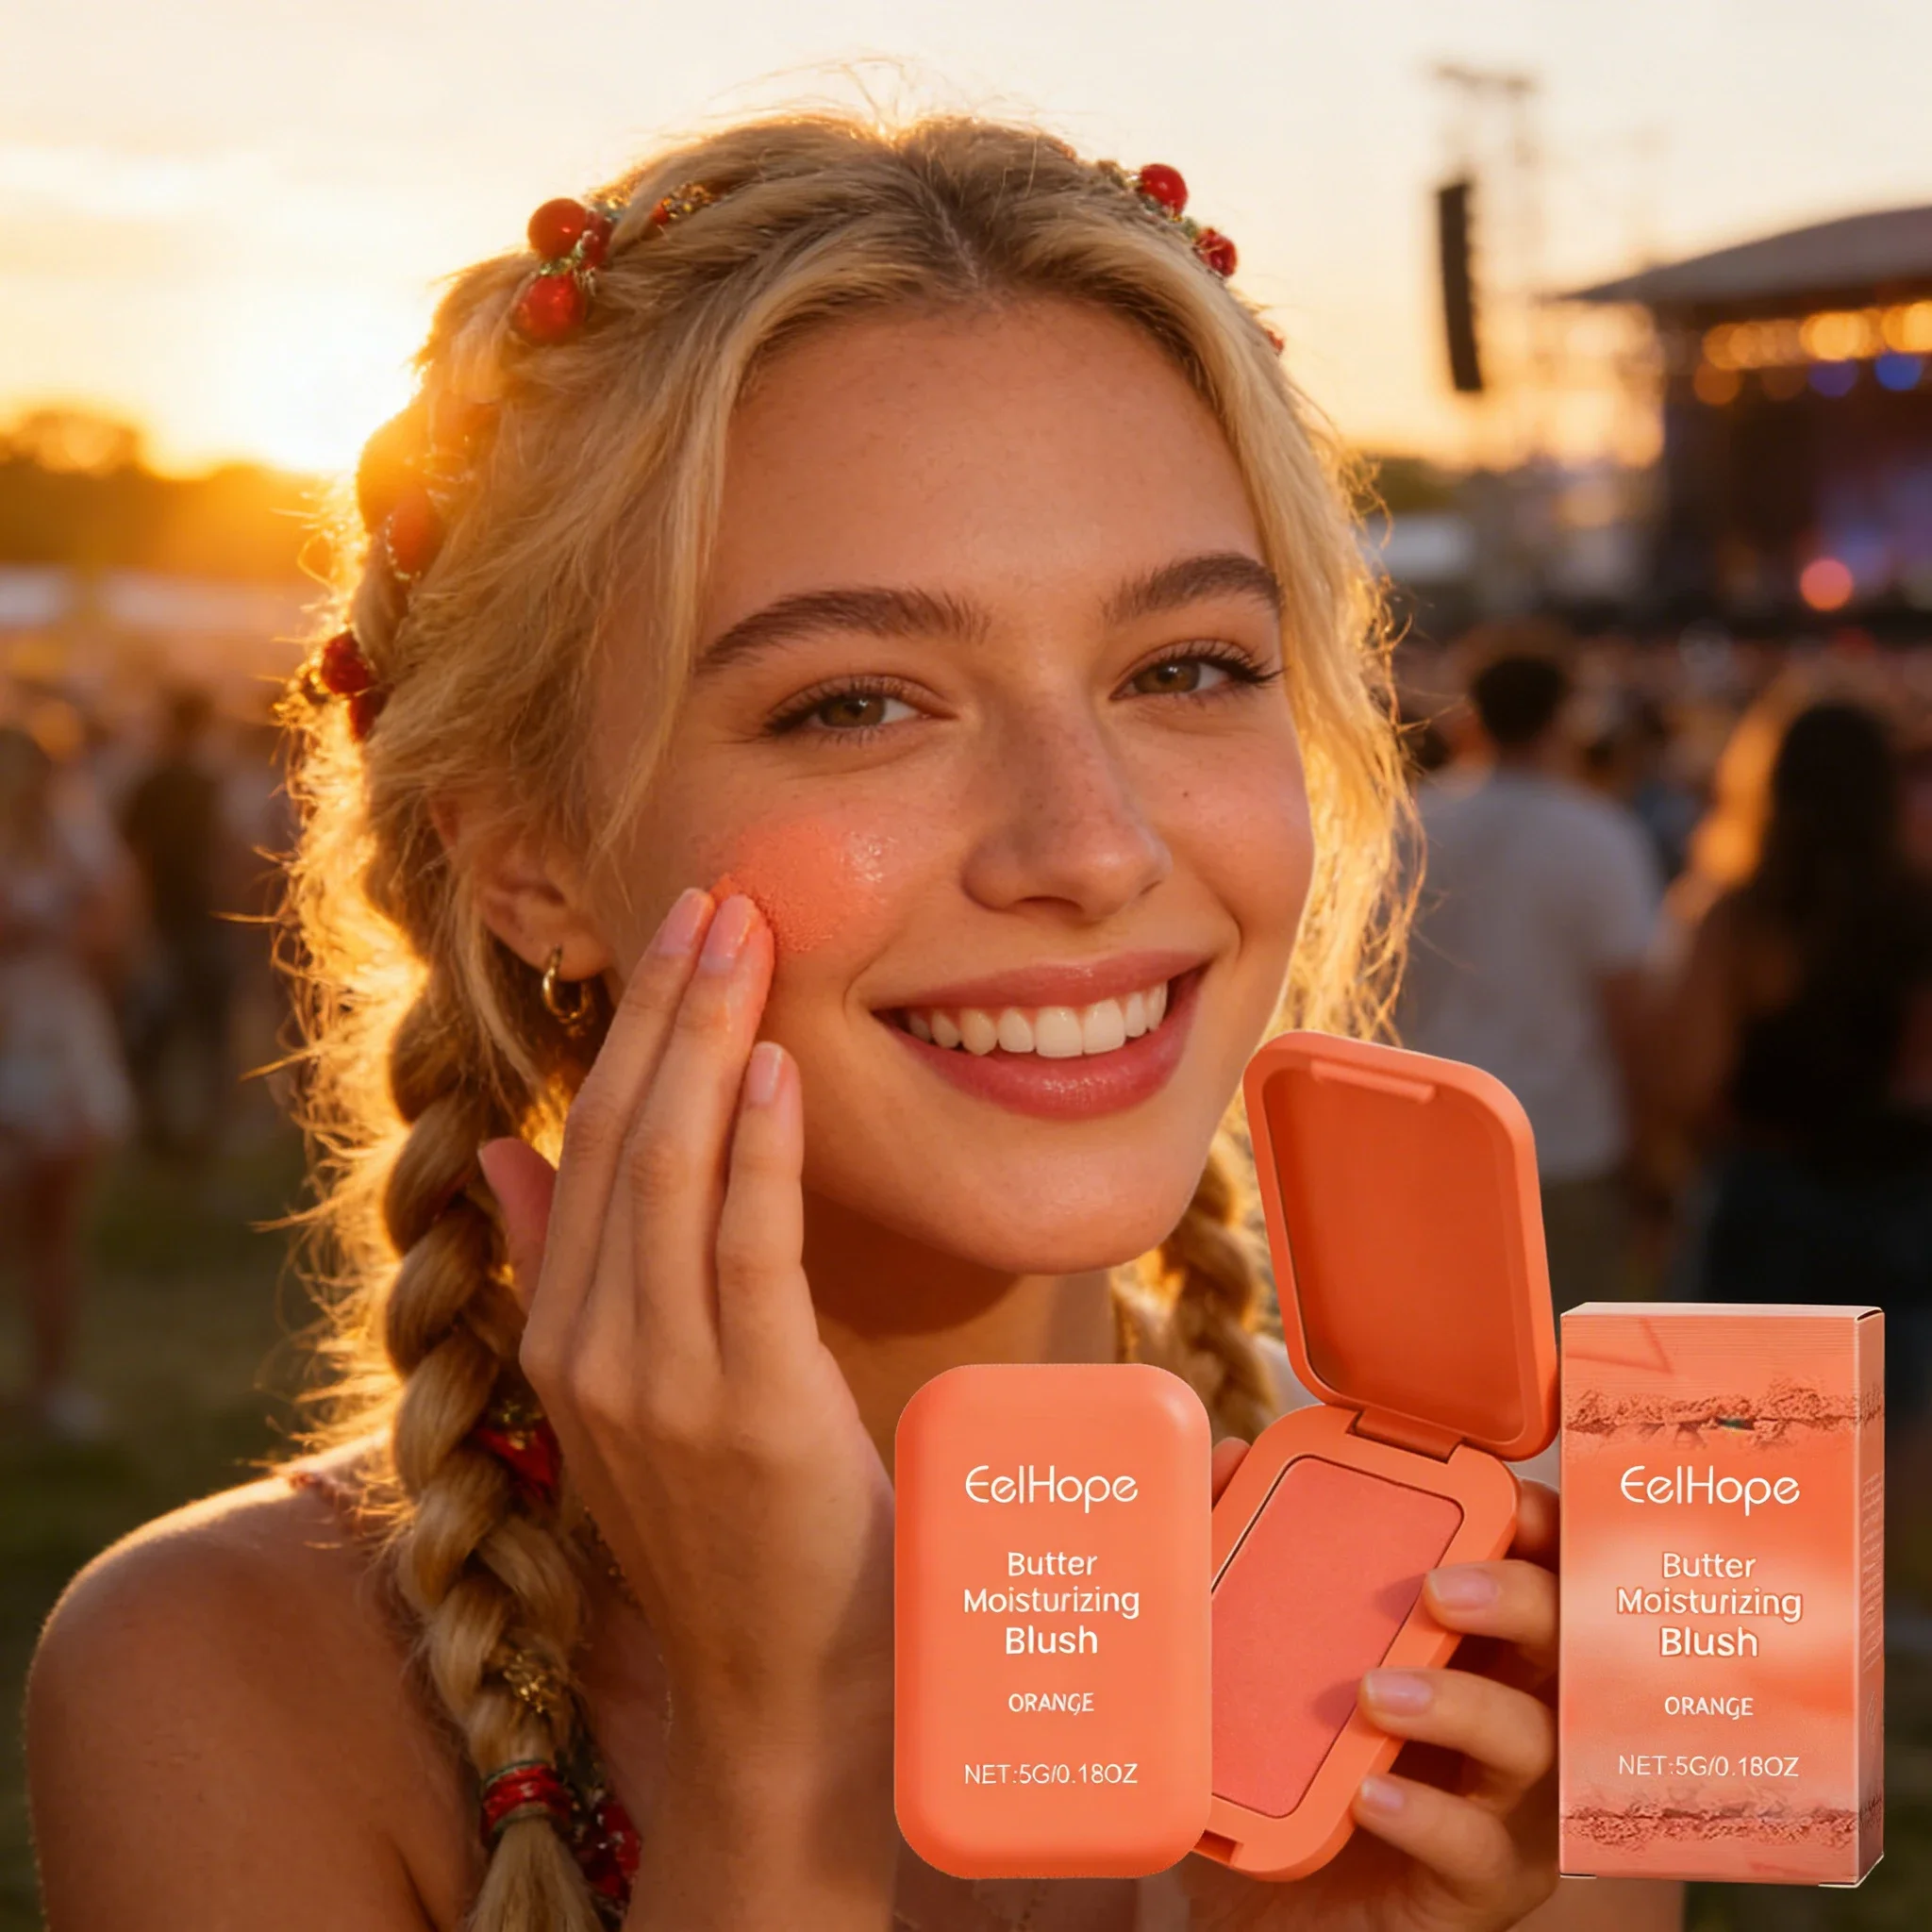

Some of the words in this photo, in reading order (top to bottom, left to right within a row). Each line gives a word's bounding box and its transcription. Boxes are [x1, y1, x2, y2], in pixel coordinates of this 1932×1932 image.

[965, 1464, 1139, 1514] EelHope
[1620, 1465, 1800, 1517] EelHope
[1008, 1551, 1098, 1577] Butter
[1663, 1553, 1756, 1578] Butter
[964, 1585, 1140, 1620] Moisturizing
[1618, 1587, 1801, 1623] Moisturizing
[1006, 1624, 1098, 1655] Blush
[1661, 1625, 1757, 1657] Blush
[1008, 1692, 1094, 1716] ORANGE
[1664, 1695, 1754, 1721] ORANGE
[964, 1762, 1139, 1785] NET:5G/0.18OZ
[1619, 1754, 1799, 1777] NET:5G/0.18OZ
